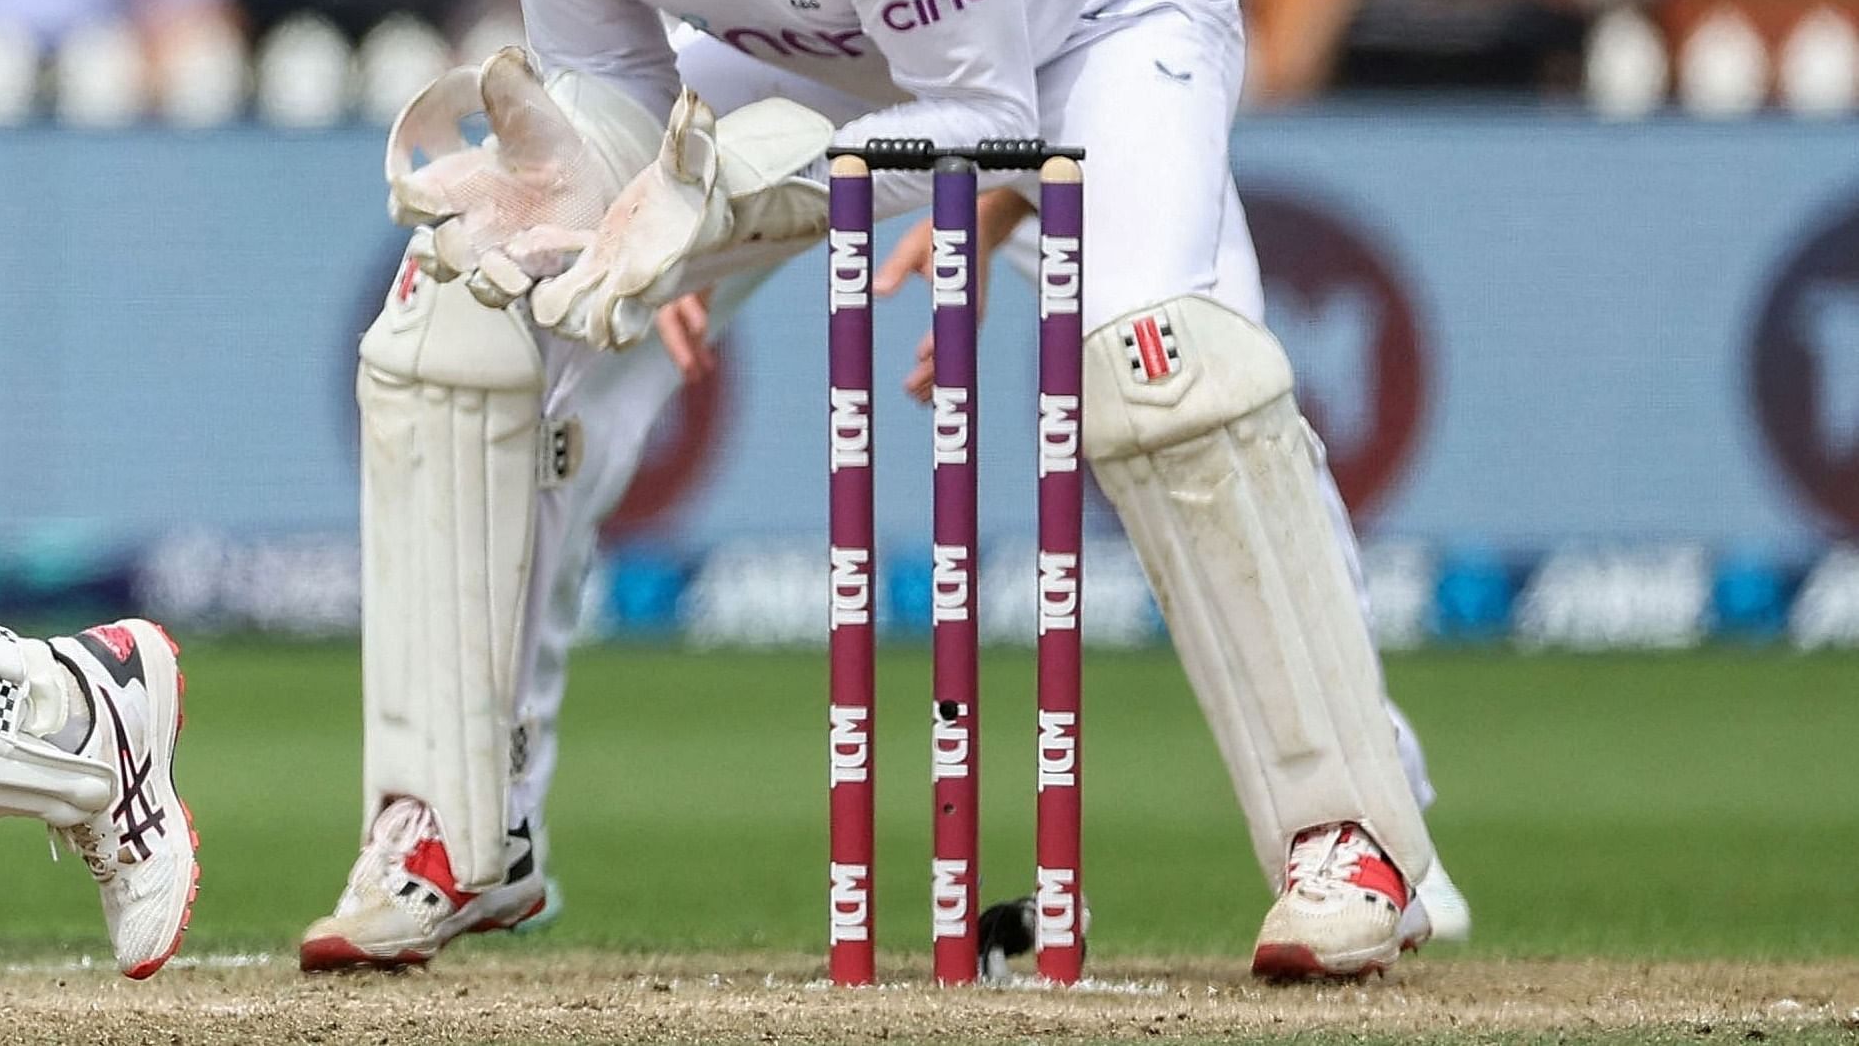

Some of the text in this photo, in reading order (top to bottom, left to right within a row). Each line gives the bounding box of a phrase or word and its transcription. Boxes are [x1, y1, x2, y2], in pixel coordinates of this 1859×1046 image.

[830, 229, 868, 314] TCM
[932, 228, 967, 311] TCM
[1041, 235, 1079, 321] TCM
[830, 387, 869, 473] TCM
[932, 385, 967, 470] TCM
[1039, 393, 1078, 479] TCM
[831, 544, 869, 630] TCM
[932, 543, 968, 627] TCM
[1039, 549, 1077, 636] TCM
[830, 702, 868, 789] TCM
[1038, 708, 1075, 793] TCM
[830, 861, 868, 946] TCM
[932, 857, 968, 942] TCM
[1037, 865, 1075, 952] TCM
